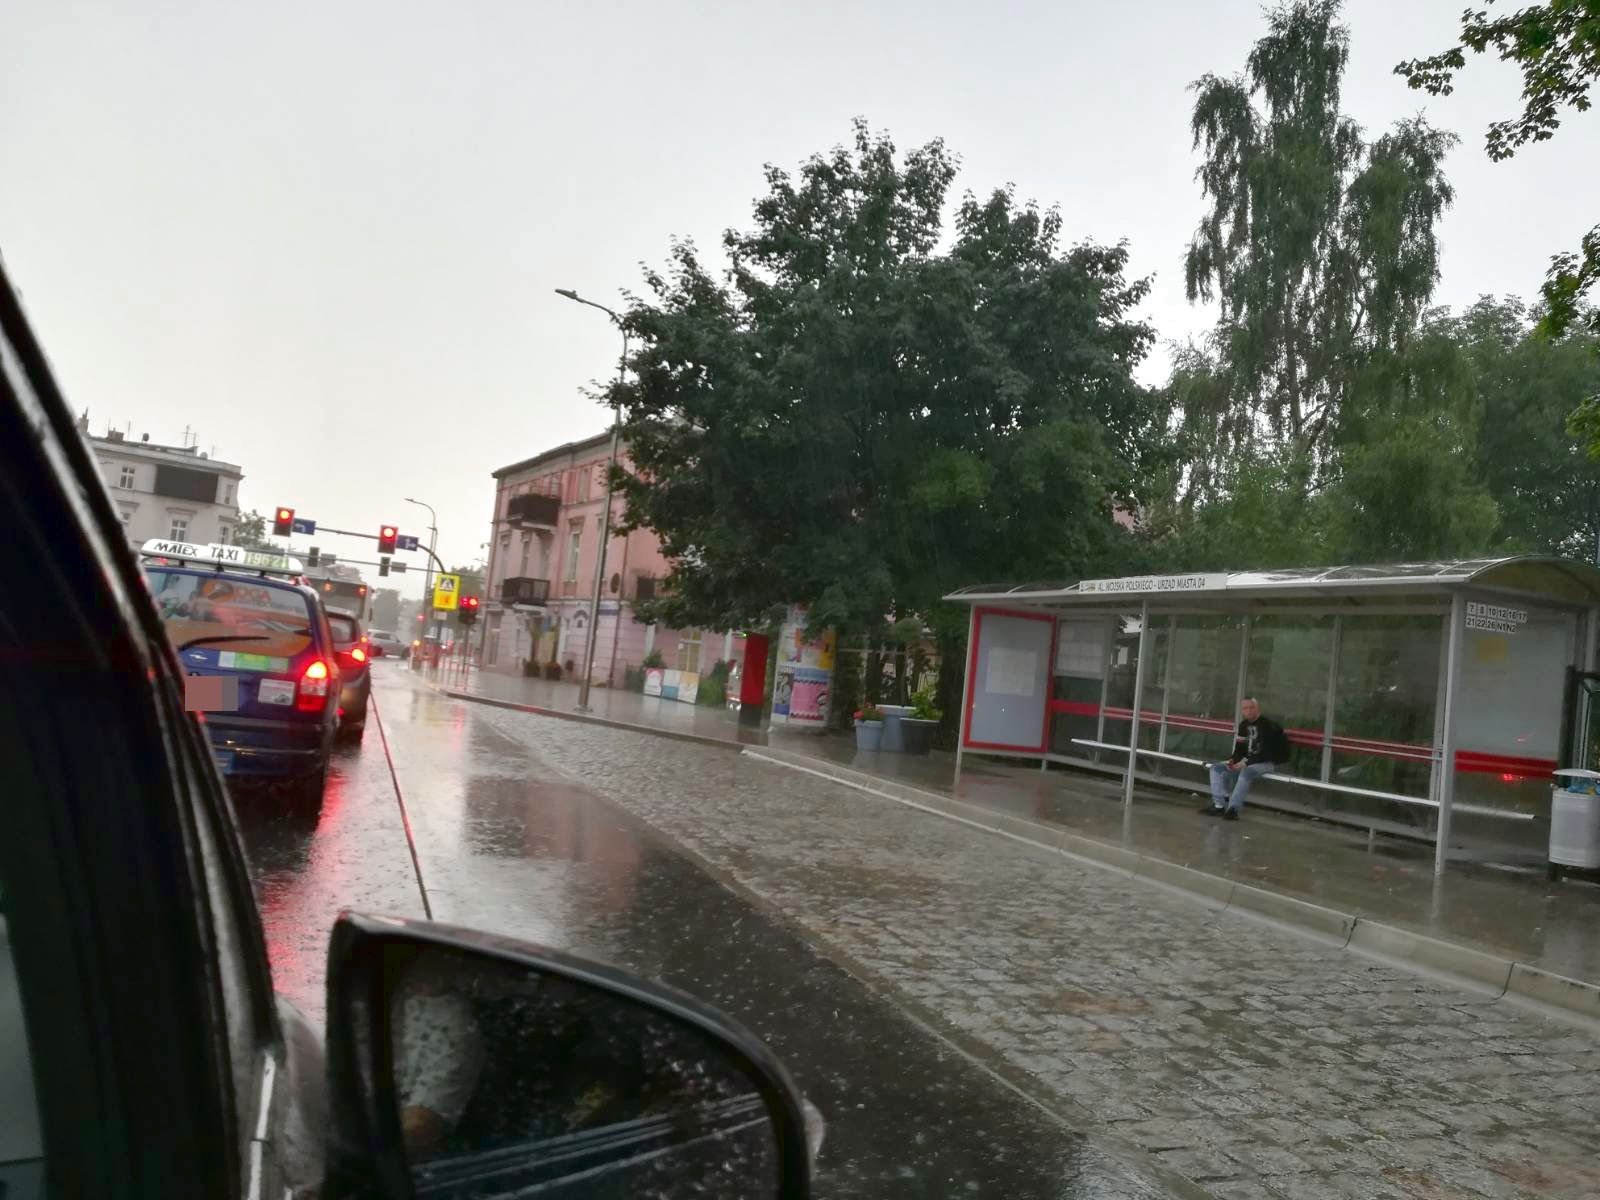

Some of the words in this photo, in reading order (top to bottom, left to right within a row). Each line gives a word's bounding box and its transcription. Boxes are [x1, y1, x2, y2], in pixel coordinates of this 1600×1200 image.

[153, 542, 198, 557] MATEX
[210, 546, 239, 561] TAXI
[1105, 581, 1125, 591] WOJSKA
[1126, 580, 1153, 591] POLSKIEGO
[1177, 578, 1197, 589] MIASTA
[1488, 608, 1496, 616] 10
[1499, 610, 1507, 618] 12
[1467, 617, 1475, 627] 21
